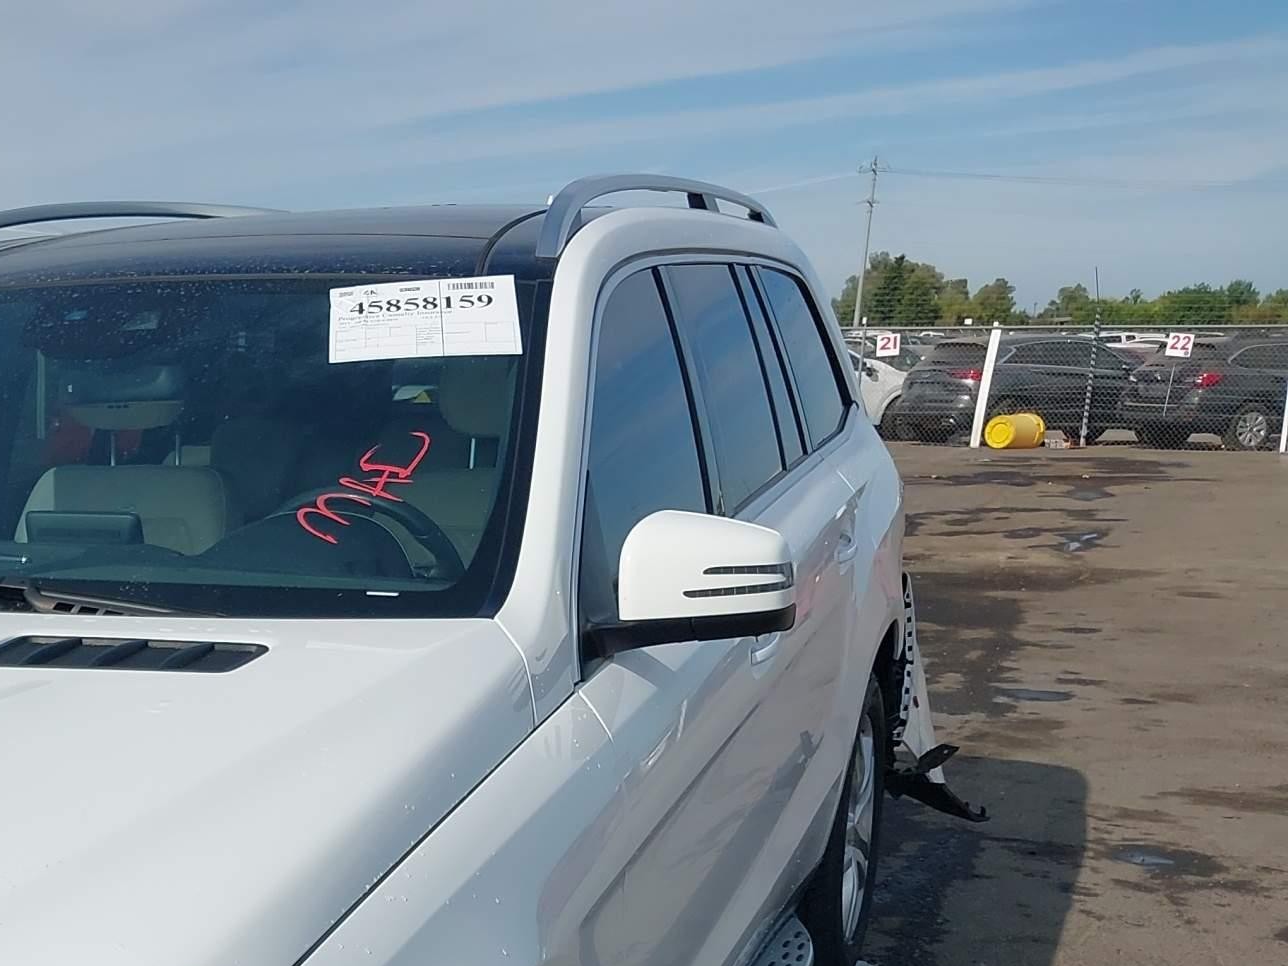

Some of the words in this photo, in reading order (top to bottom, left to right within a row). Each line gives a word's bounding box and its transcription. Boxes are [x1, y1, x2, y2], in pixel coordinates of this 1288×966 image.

[350, 293, 494, 315] 45858159
[879, 335, 898, 351] 21
[1169, 335, 1192, 351] 22
